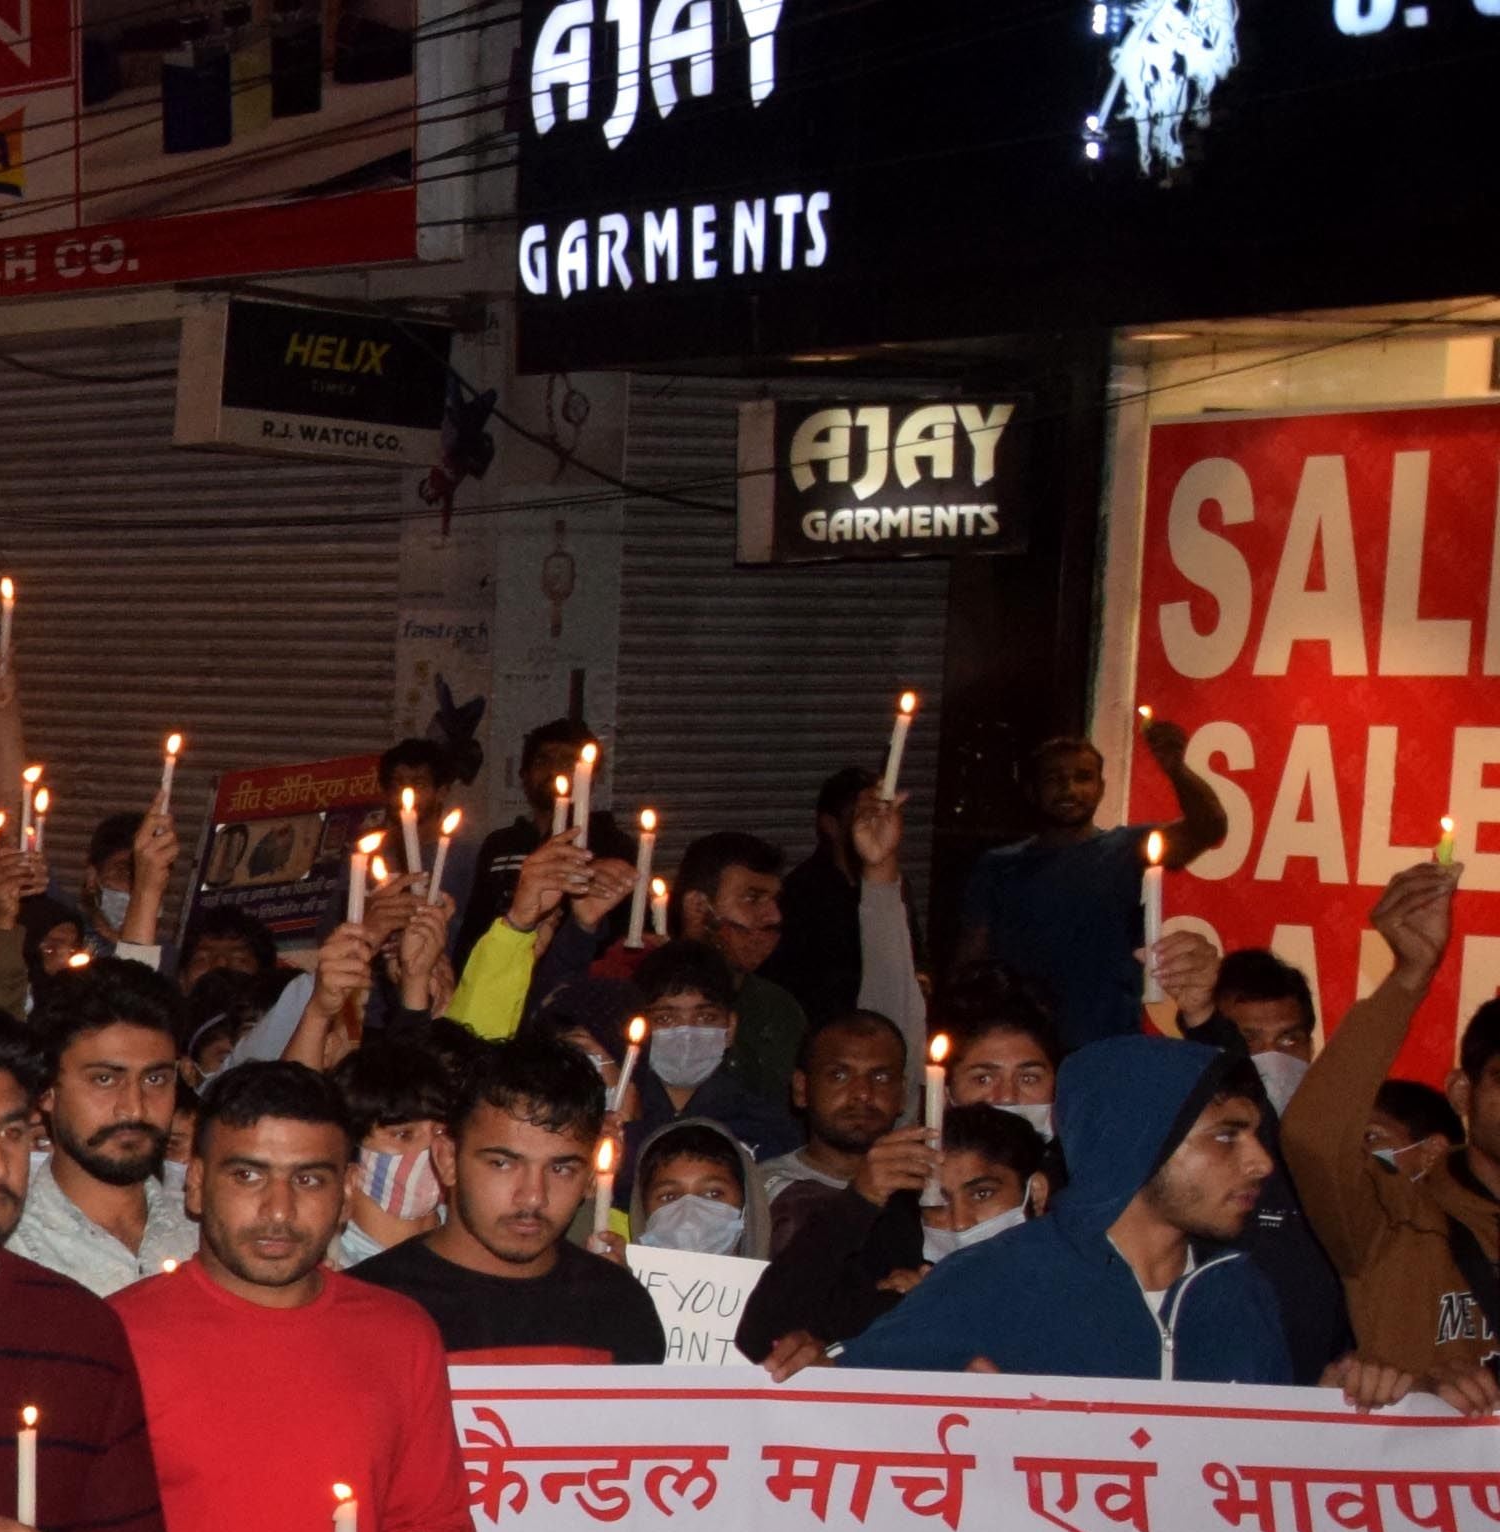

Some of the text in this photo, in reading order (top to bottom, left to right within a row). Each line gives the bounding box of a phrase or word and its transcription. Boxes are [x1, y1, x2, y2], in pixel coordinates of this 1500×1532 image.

[530, 0, 783, 150] AJAY
[54, 234, 140, 279] CO.
[518, 193, 832, 300] GARMENTS
[283, 331, 394, 376] HELIX
[261, 420, 293, 439] R.J.
[299, 424, 368, 448] WATCH
[789, 404, 1016, 500] AJAY
[802, 504, 1000, 544] GARMENTS
[1159, 450, 1500, 680] SAL
[668, 1279, 741, 1318] YOU
[666, 1326, 736, 1366] ANT
[761, 1413, 977, 1532] मार्च
